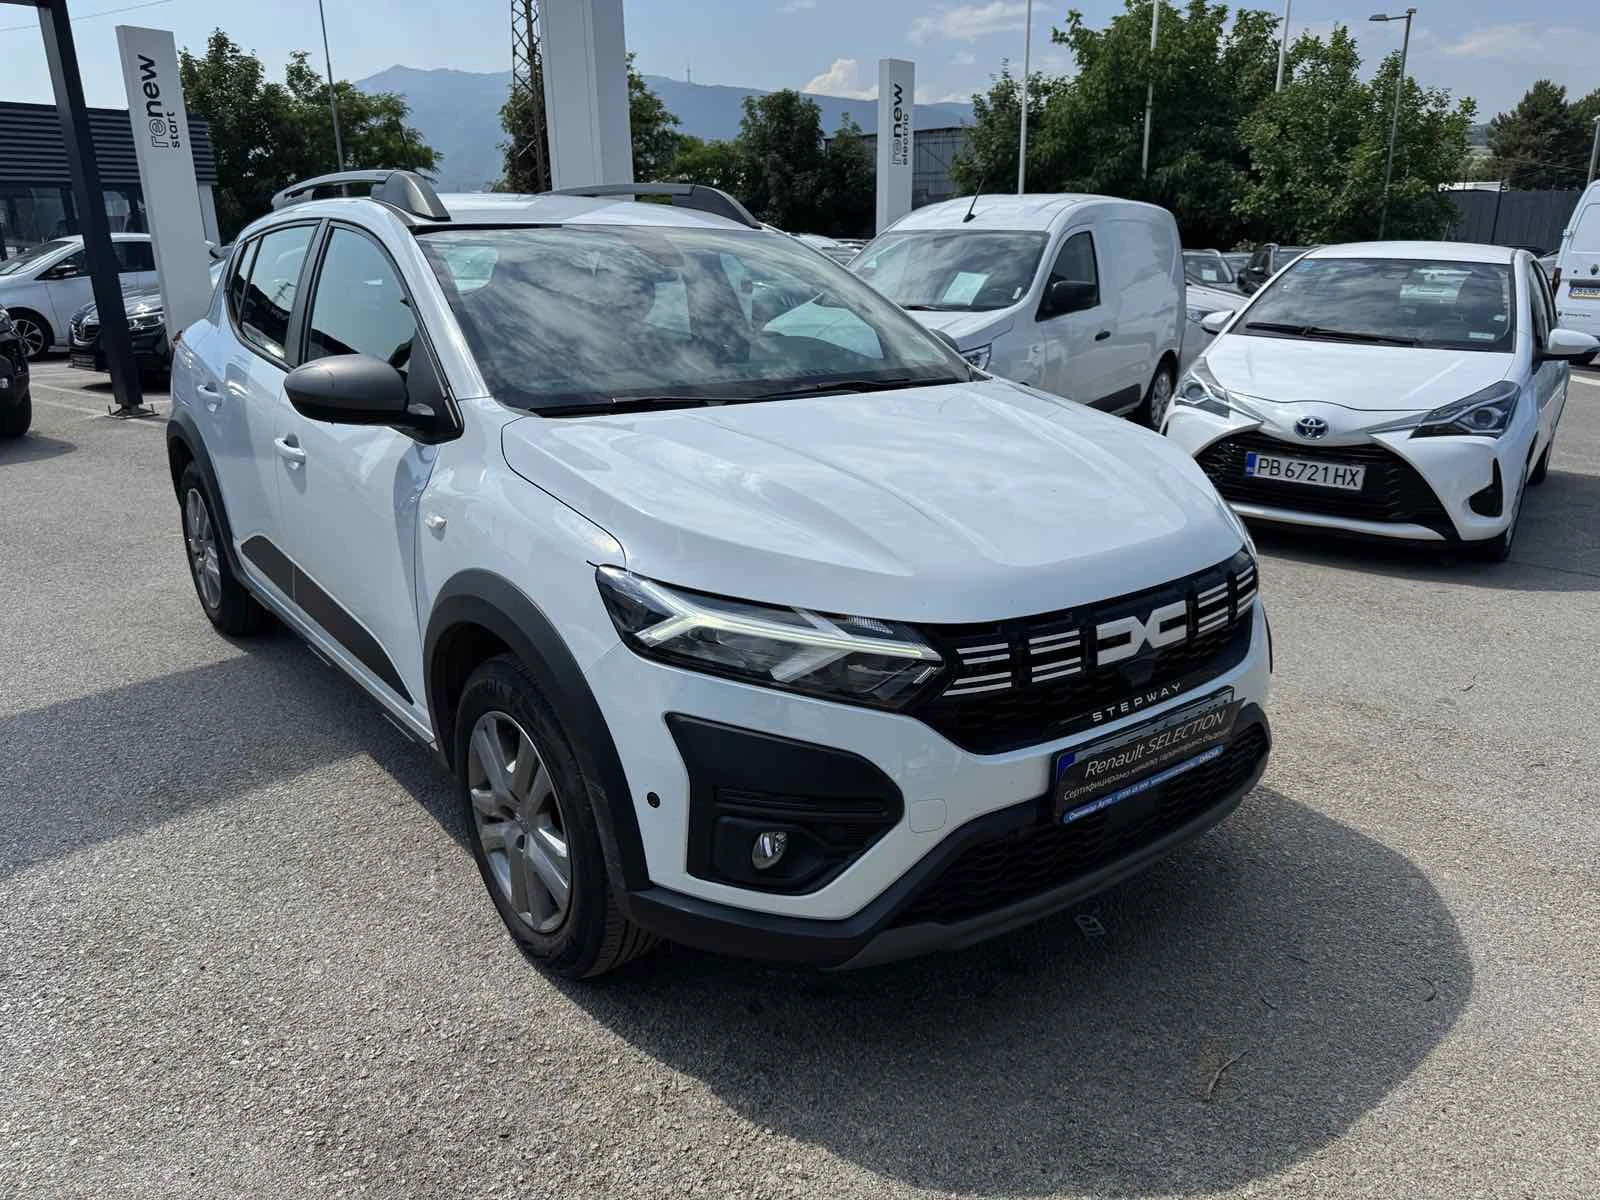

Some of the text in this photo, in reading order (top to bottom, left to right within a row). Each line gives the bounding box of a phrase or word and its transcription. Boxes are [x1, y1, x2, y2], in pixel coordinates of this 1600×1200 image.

[137, 54, 168, 148] renew
[891, 83, 903, 166] renew
[167, 112, 180, 149] start
[1257, 458, 1361, 487] PB 6721 HX
[1092, 682, 1181, 722] STEPWAY
[1084, 743, 1145, 778] Renault
[1146, 709, 1226, 755] SELECTION
